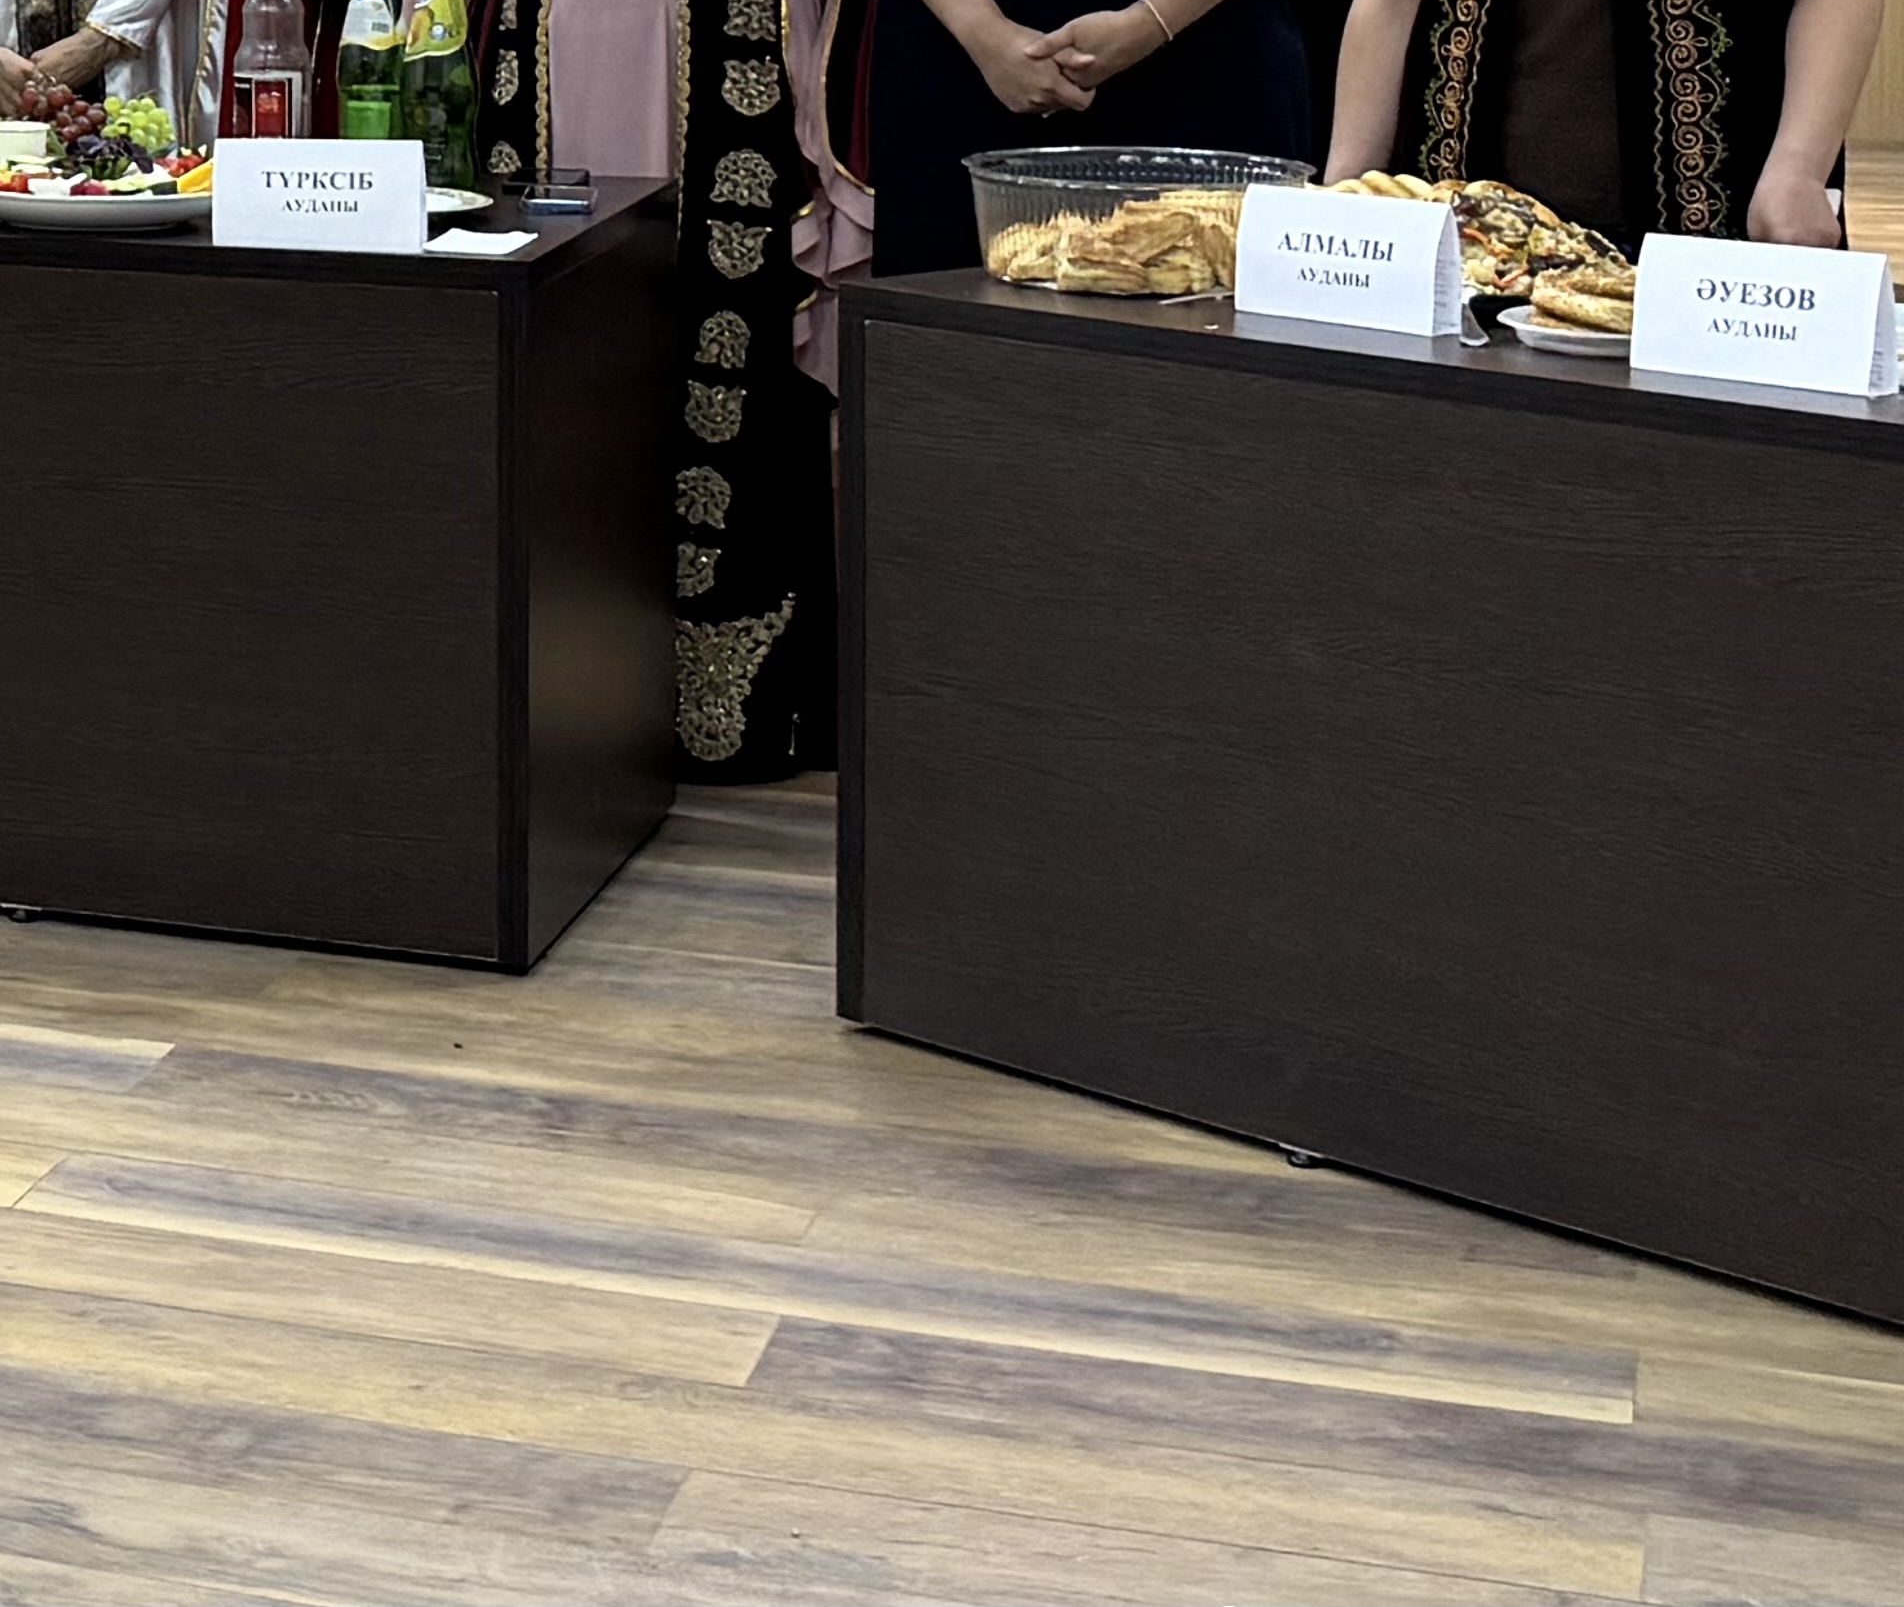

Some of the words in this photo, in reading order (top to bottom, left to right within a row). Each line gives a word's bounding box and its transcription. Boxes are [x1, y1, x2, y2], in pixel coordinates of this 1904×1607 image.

[261, 171, 373, 191] ТҮРКСІБ
[282, 199, 359, 213] АУДАНЫ
[1278, 232, 1394, 261] АЛМАЛЫ
[1297, 267, 1370, 288] АУДАНЫ
[1696, 278, 1816, 311] ӘУЕЗОВ
[1707, 318, 1797, 341] АУДАНЫ
